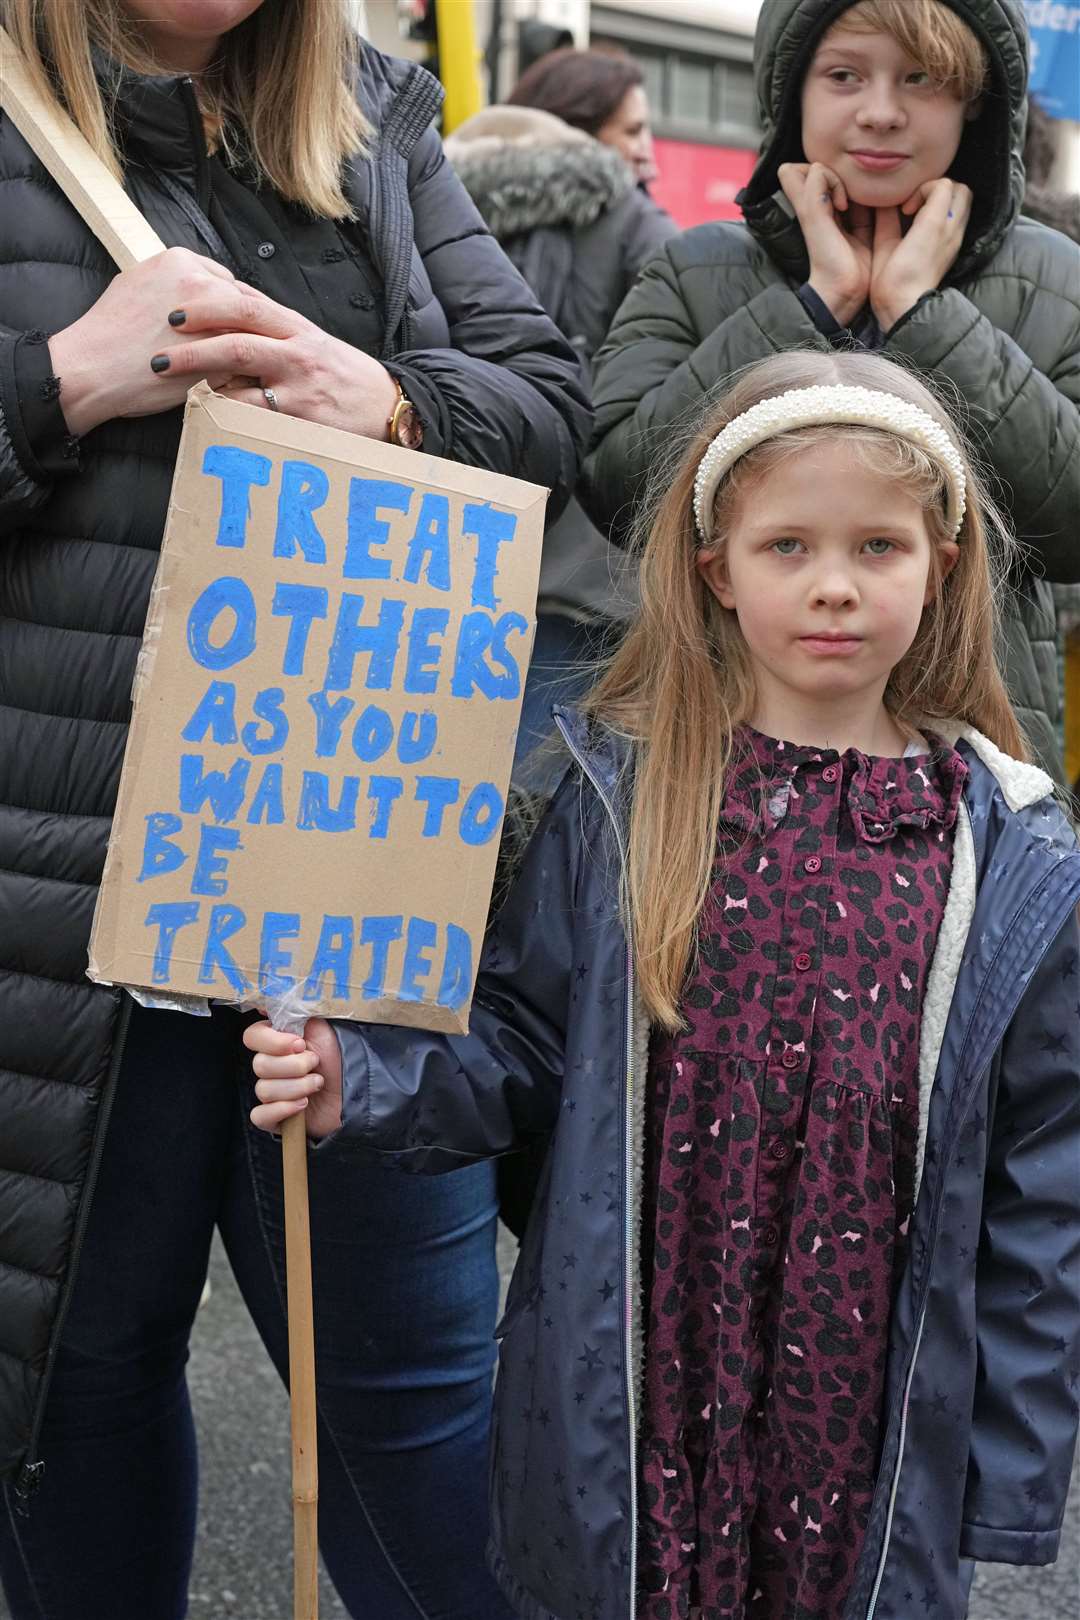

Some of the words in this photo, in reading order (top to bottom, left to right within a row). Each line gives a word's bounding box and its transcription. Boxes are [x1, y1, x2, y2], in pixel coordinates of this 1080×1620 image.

[203, 445, 517, 610] TREAT
[187, 576, 528, 701] OTHERS
[181, 680, 290, 756] AS
[308, 691, 438, 764] YOU
[179, 753, 404, 839] WANT
[414, 775, 506, 846] TO
[136, 812, 245, 897] BE
[144, 901, 473, 1011] TREATED
